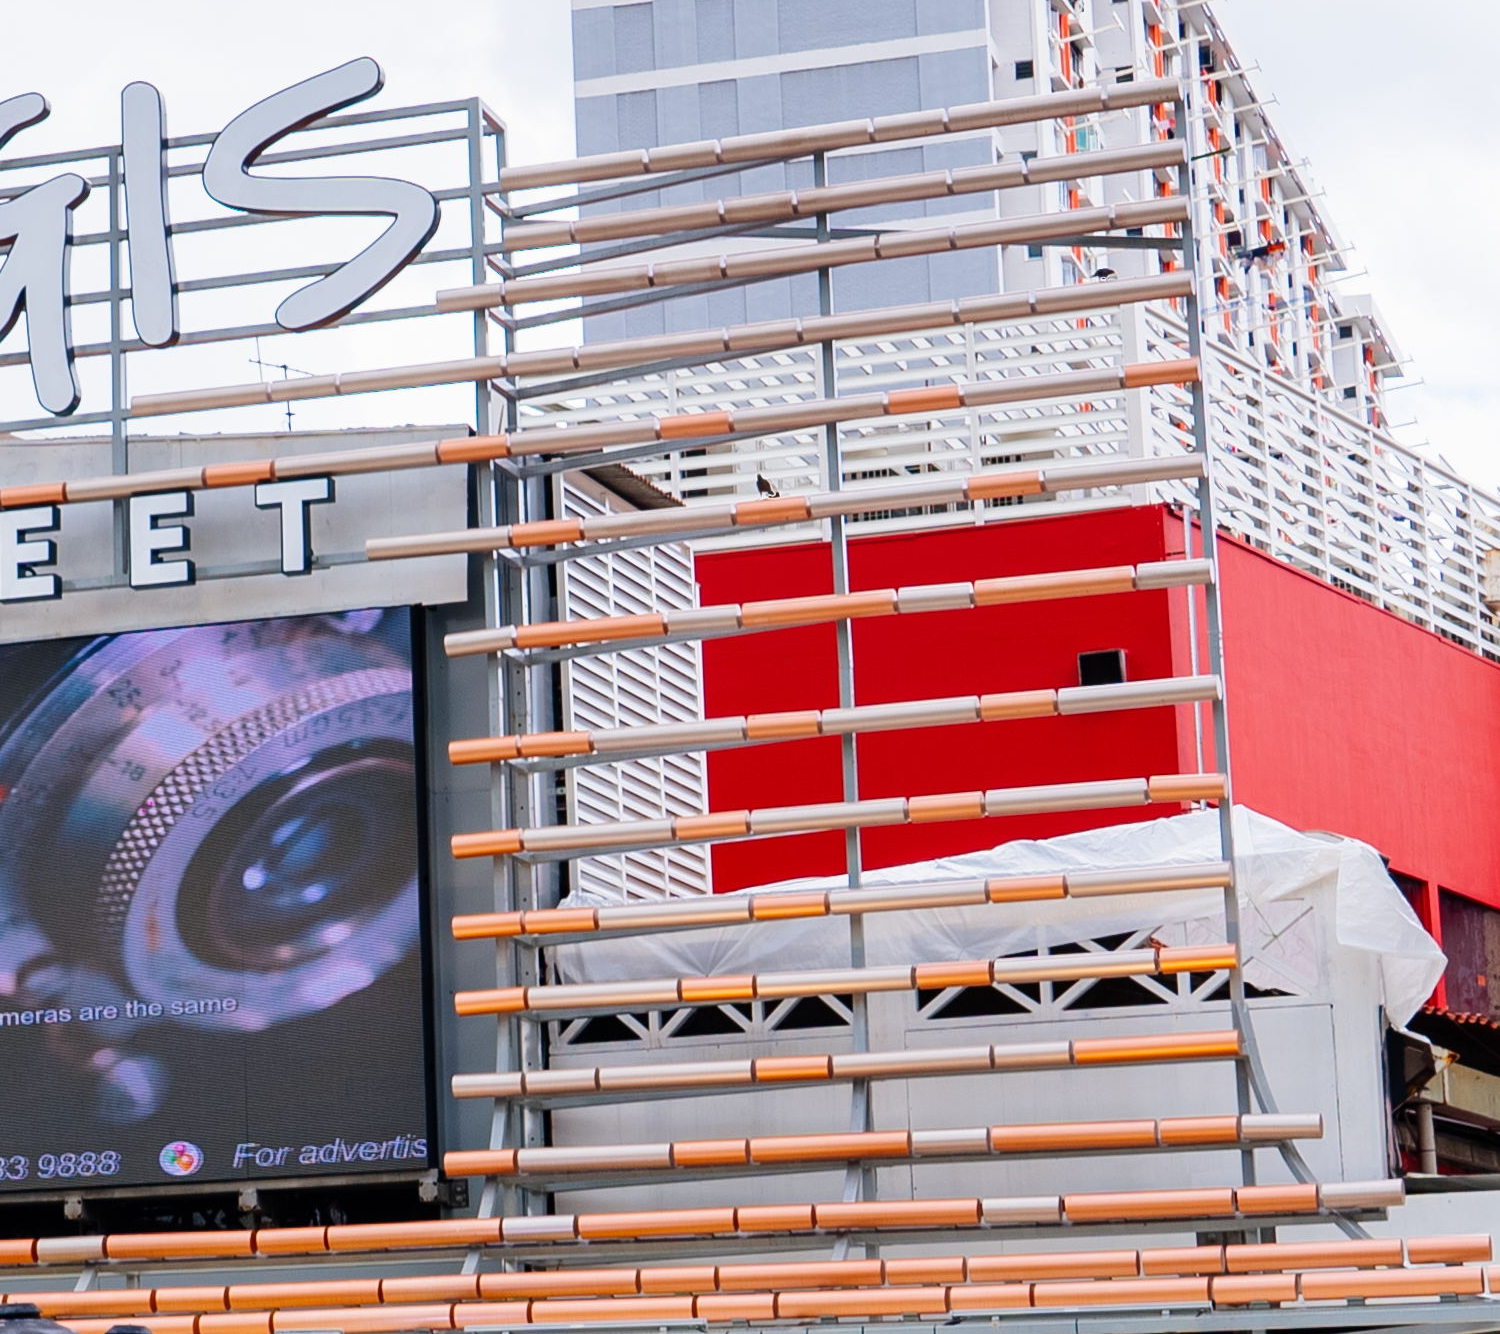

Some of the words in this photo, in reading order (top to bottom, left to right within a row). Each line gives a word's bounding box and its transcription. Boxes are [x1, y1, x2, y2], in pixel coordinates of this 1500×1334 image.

[79, 1004, 119, 1022] are
[125, 999, 163, 1018] the
[170, 996, 239, 1016] same
[37, 1150, 122, 1179] 9888
[233, 1142, 293, 1169] For
